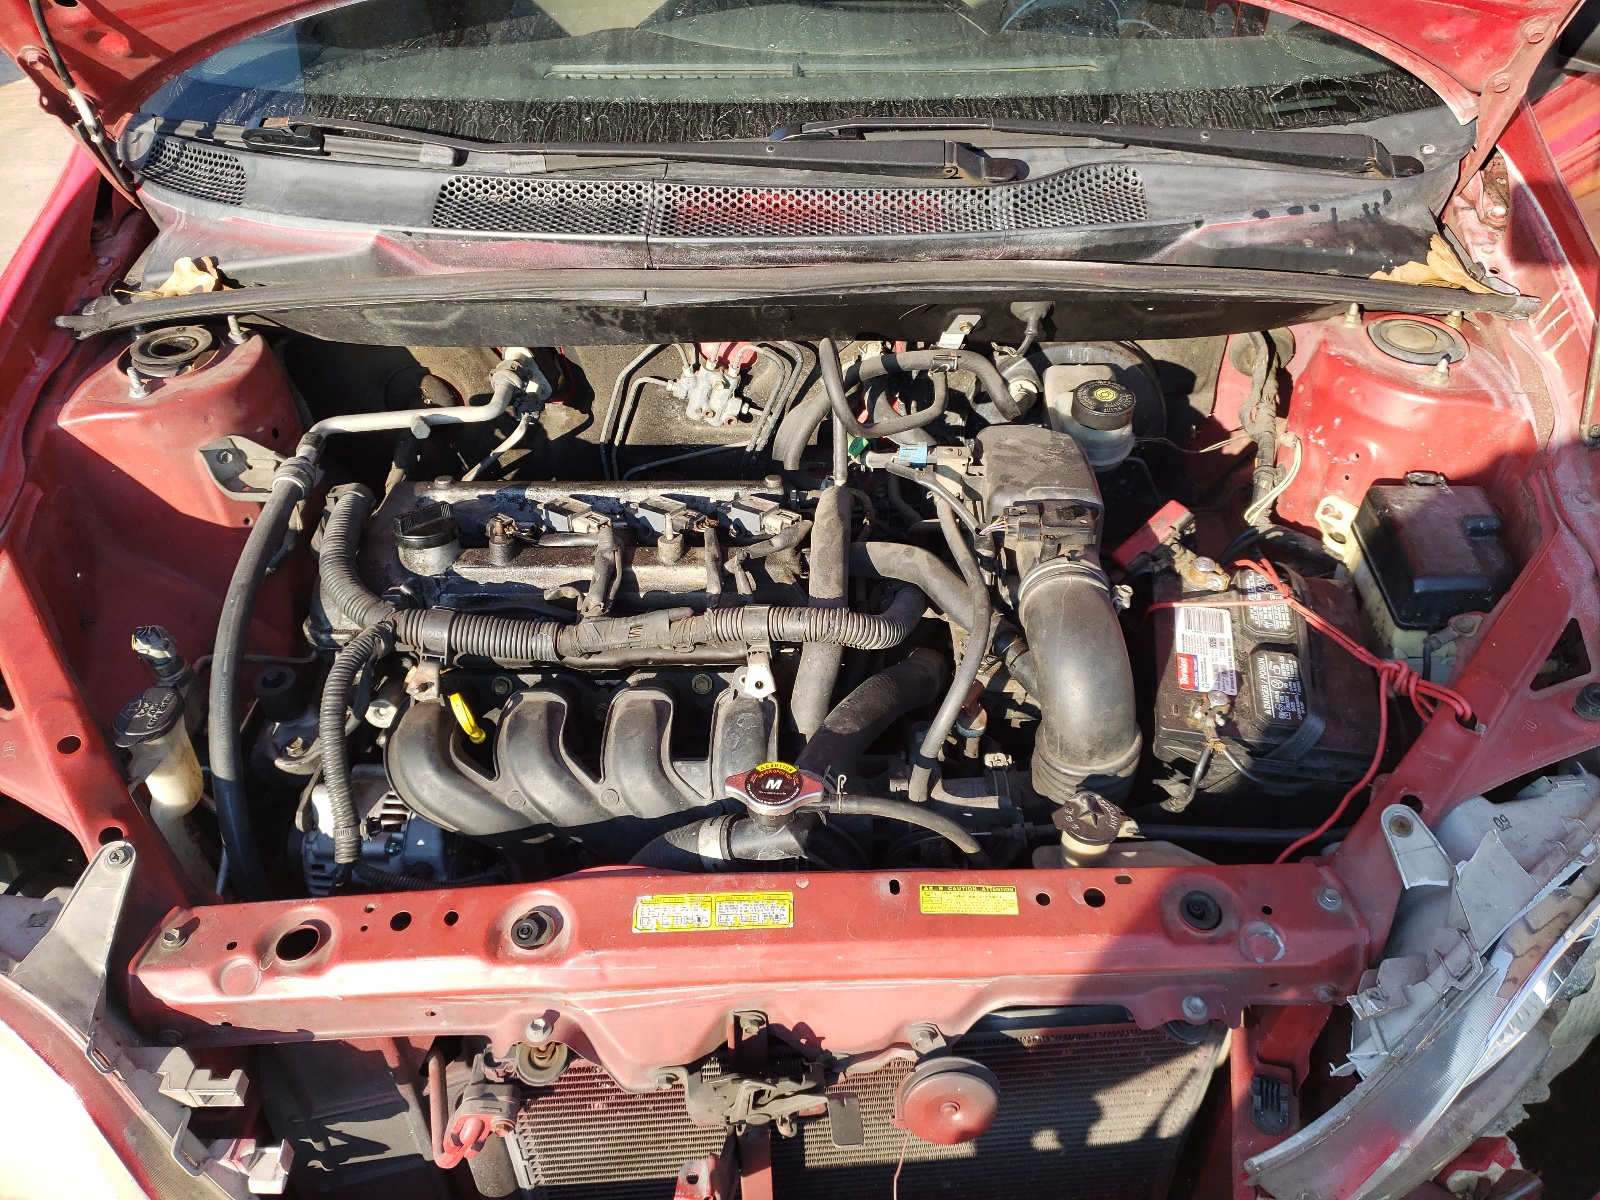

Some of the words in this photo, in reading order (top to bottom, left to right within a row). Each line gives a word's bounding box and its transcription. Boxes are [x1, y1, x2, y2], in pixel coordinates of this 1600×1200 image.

[1178, 656, 1189, 685] Duralast
[1257, 657, 1268, 680] POISON
[1261, 685, 1272, 708] DANGER
[766, 763, 794, 772] CAUTION
[765, 780, 783, 790] M
